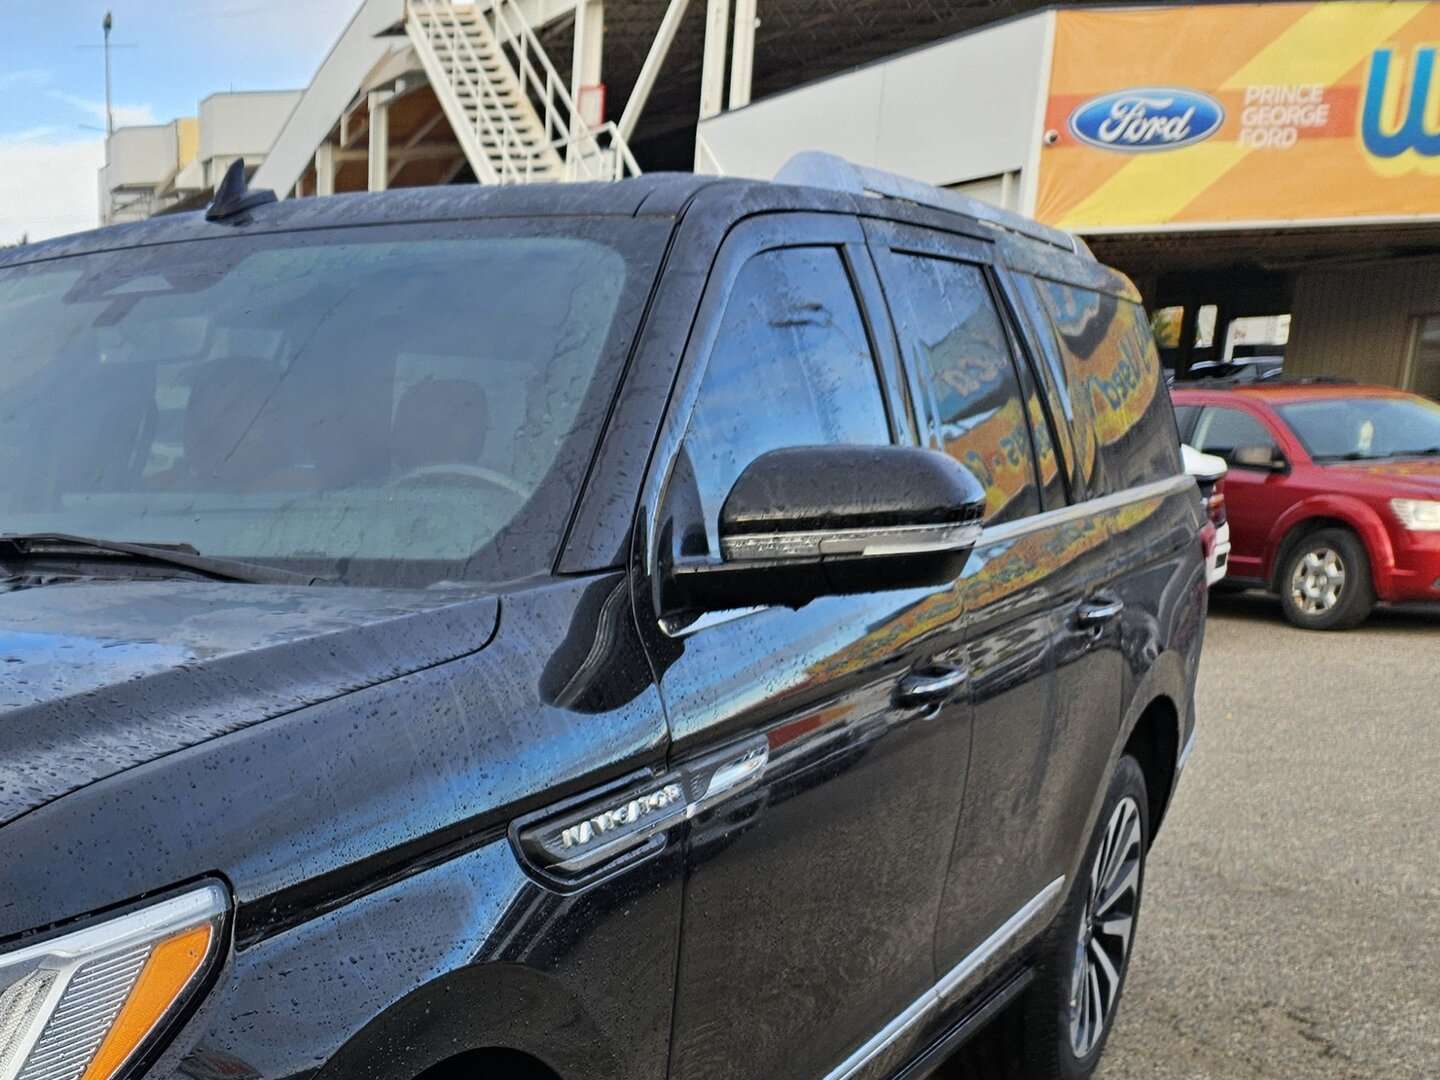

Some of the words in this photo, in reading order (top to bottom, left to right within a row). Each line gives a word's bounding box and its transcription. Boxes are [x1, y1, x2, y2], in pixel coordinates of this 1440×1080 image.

[1243, 84, 1325, 105] PRINCE
[1098, 97, 1196, 144] Ford
[1240, 103, 1330, 127] GEORGE
[1238, 127, 1298, 149] FORD
